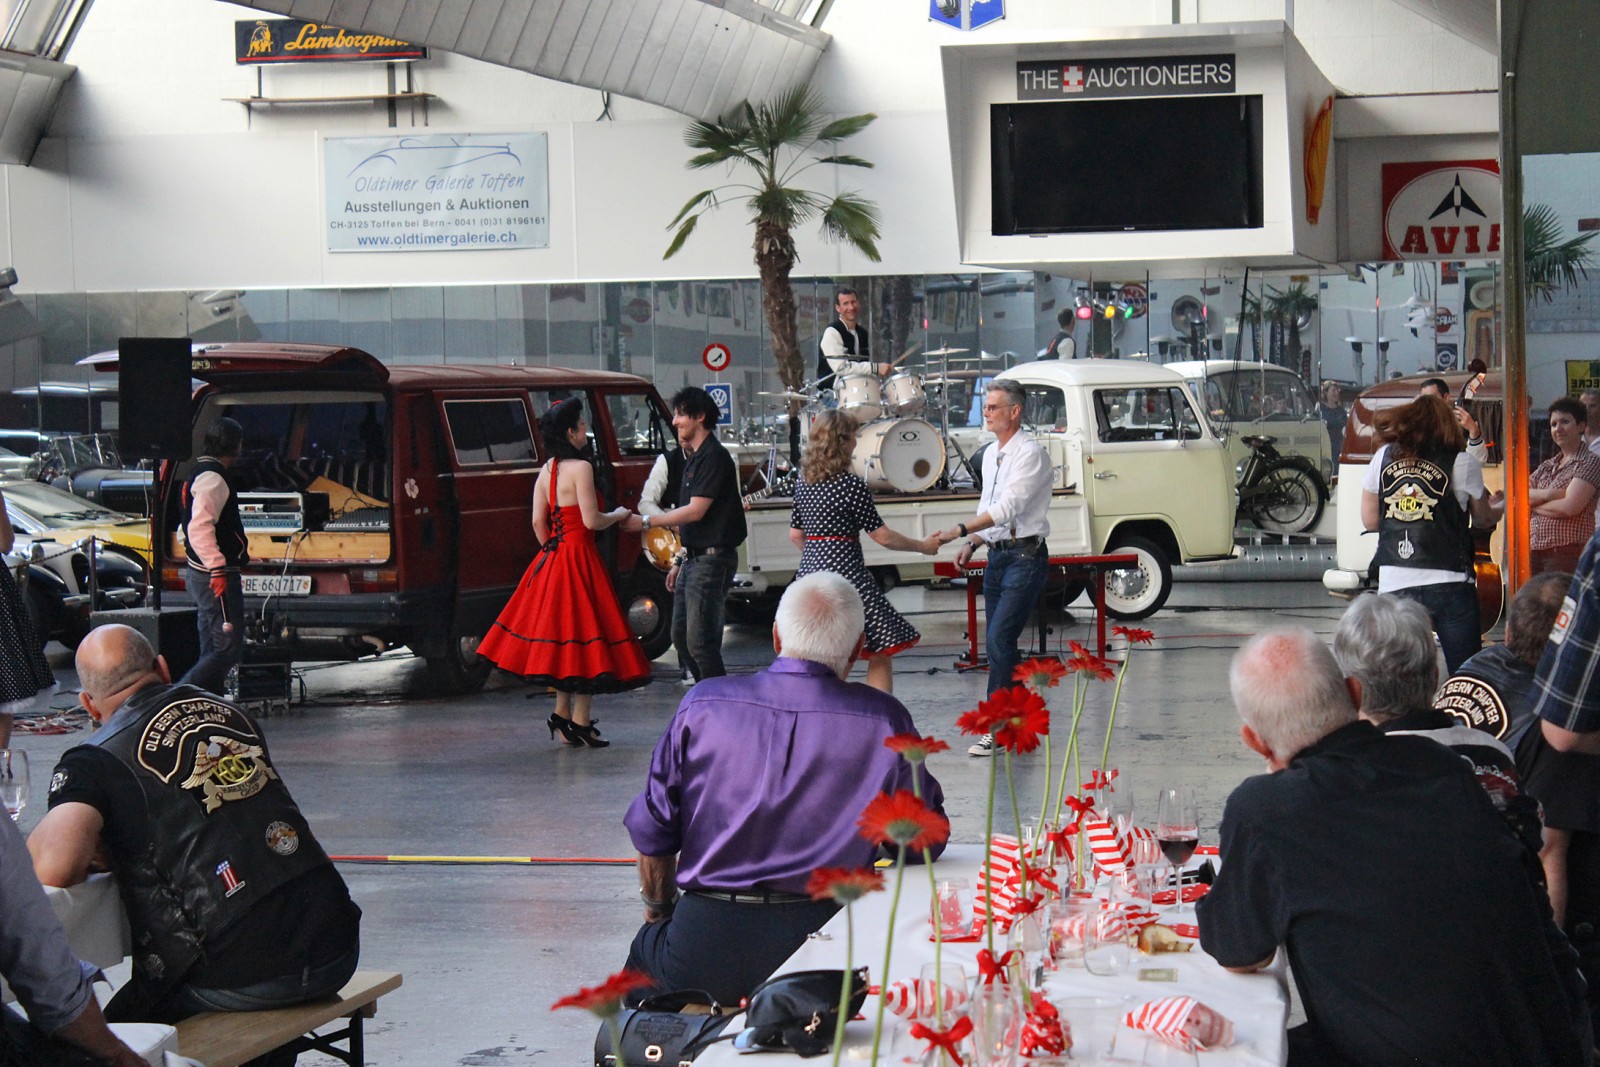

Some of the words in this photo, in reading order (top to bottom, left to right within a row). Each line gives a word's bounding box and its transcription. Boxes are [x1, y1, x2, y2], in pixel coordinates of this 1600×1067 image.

[285, 23, 409, 53] Lamborgh
[1020, 70, 1059, 90] THE
[1086, 63, 1232, 88] AUCTIONEERS
[355, 176, 419, 192] Oldtimer
[425, 174, 475, 194] Galerie
[480, 173, 525, 192] Toffen
[344, 200, 441, 214] Ausstellungen
[446, 199, 455, 211] &
[459, 198, 529, 211] Auktionen
[330, 220, 369, 229] CH-3125
[371, 219, 402, 228] Toffen
[405, 219, 419, 228] bei
[423, 218, 445, 228] Bern
[455, 218, 476, 227] 0041
[480, 217, 503, 227] (0)31
[506, 216, 546, 226] 8196161
[357, 231, 517, 246] www.oldtimergalerie.ch
[1416, 460, 1443, 480] CHAPTER
[1435, 696, 1485, 725] SWITZERLAND
[1446, 681, 1474, 695] BERN
[1472, 687, 1500, 725] CHAPTER
[145, 731, 161, 752] OLD
[154, 707, 182, 732] BERN
[181, 703, 232, 717] CHAPTER
[162, 713, 226, 748] SWITZERLAND
